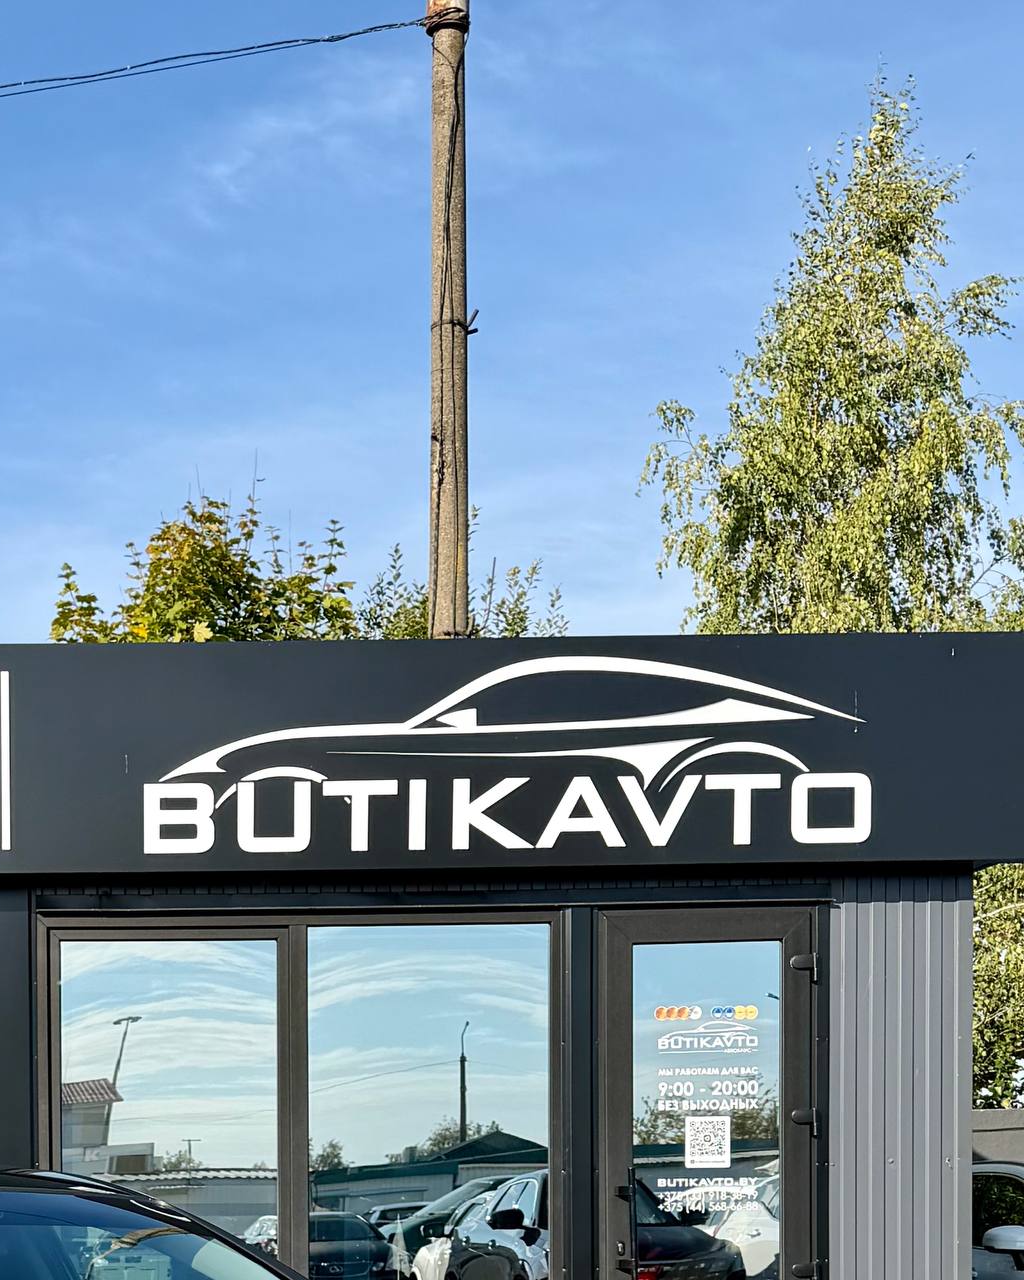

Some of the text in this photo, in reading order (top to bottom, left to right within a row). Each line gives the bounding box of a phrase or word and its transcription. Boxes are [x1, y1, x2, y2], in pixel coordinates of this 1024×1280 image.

[143, 772, 872, 854] BUTIKAVTO
[657, 1036, 759, 1049] BUTIKAVTO
[740, 1066, 758, 1075] ВАС
[658, 1081, 694, 1097] 9:00
[711, 1080, 758, 1096] 20:00
[658, 1098, 758, 1111] БЕЗ ВЫХОДНЫХ
[657, 1177, 758, 1187] BUTIKAVTO.BY
[658, 1202, 683, 1212] +375
[685, 1201, 705, 1213] (44)
